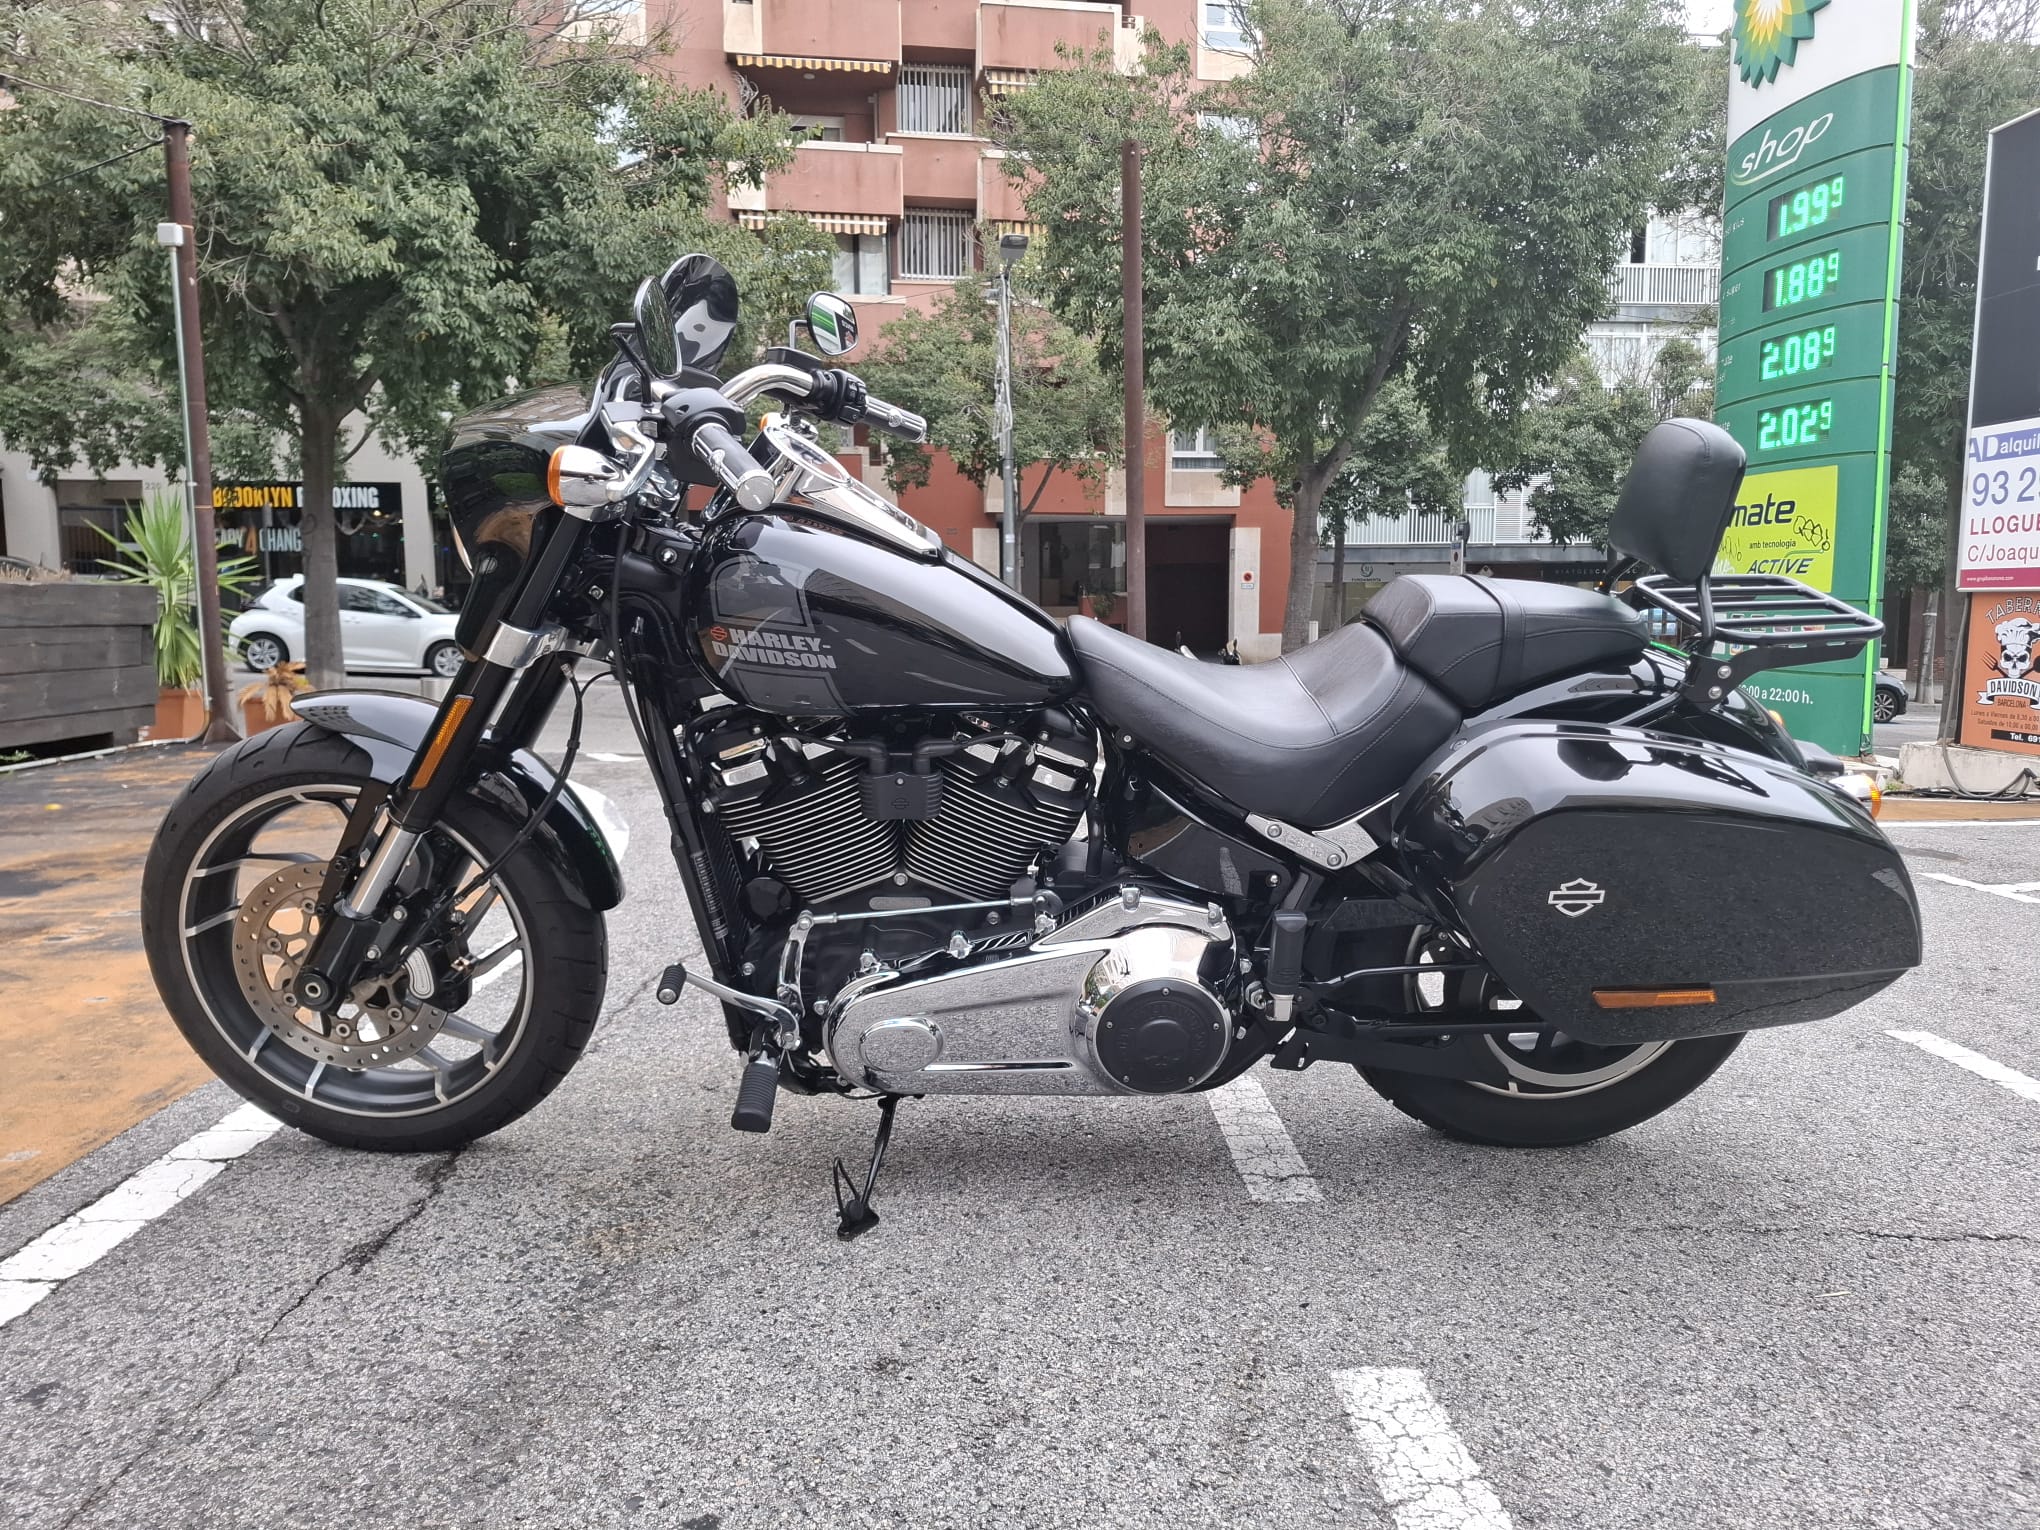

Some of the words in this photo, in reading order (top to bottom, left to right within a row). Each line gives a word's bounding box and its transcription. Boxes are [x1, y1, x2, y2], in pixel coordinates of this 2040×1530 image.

[1731, 112, 1834, 186] shop
[1972, 470, 2009, 507] 93
[2017, 466, 2040, 502] 2
[1727, 493, 1795, 528] mate
[258, 527, 302, 552] CHANG
[1746, 558, 1814, 574] ACTIVE
[728, 628, 831, 652] HARLEY-
[711, 640, 837, 669] DAVIDSON
[1769, 687, 1800, 703] 22:00
[1801, 691, 1814, 705] h.
[1990, 680, 2038, 698] DAVIDSON
[1997, 698, 2026, 708] BARCELONA
